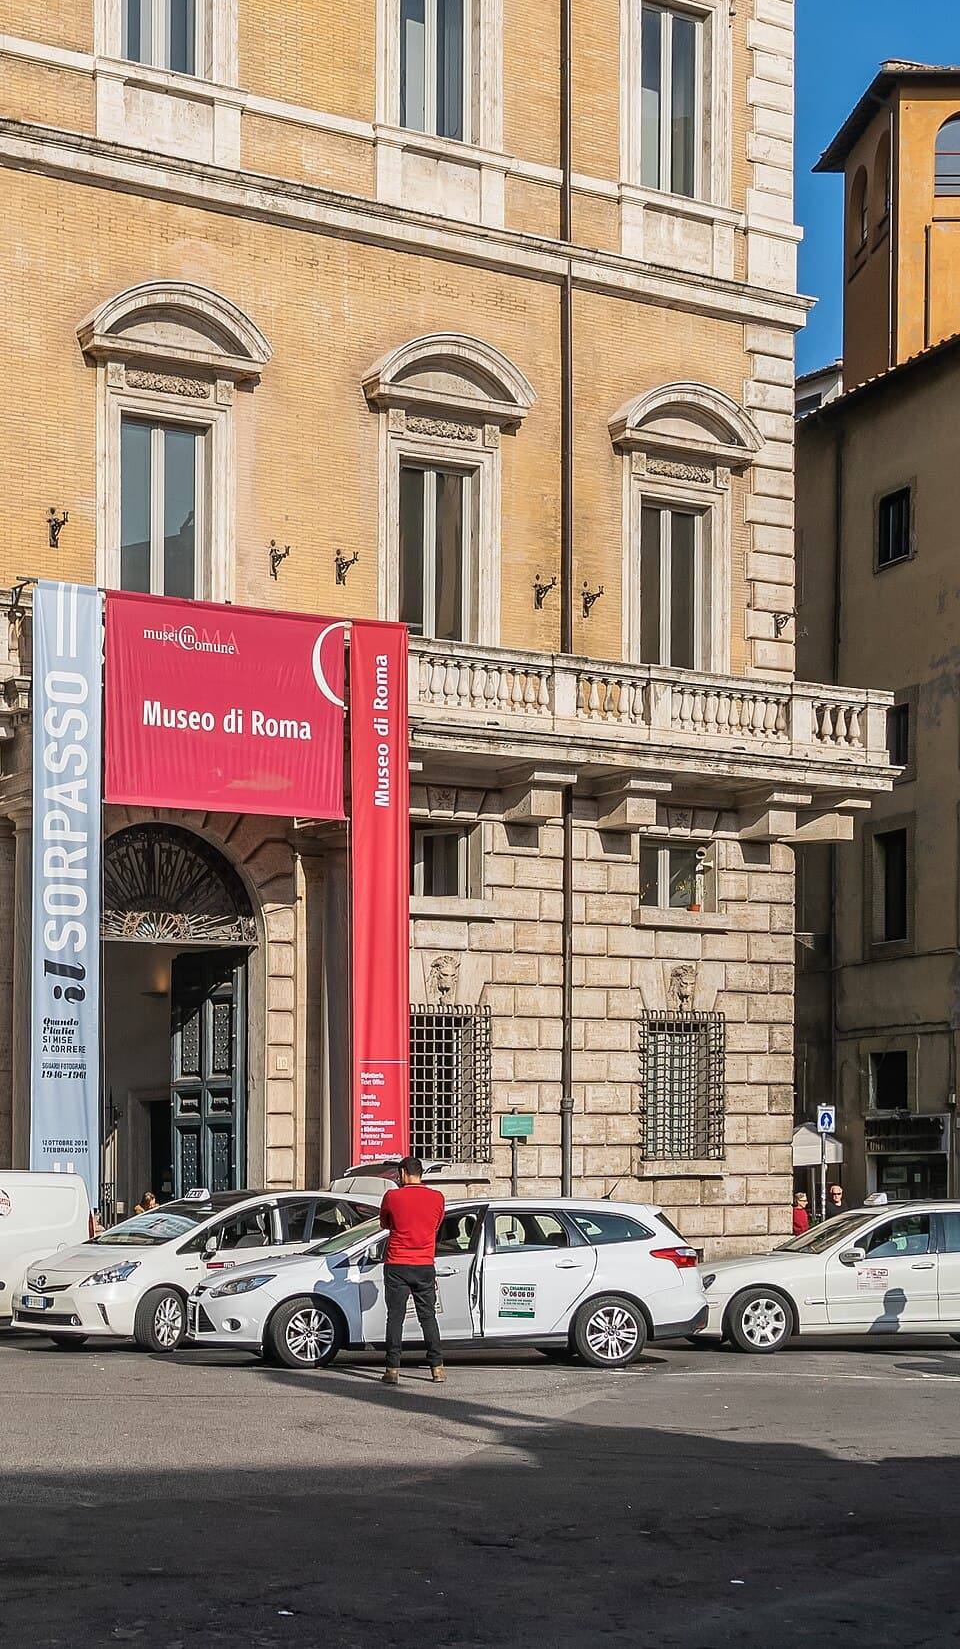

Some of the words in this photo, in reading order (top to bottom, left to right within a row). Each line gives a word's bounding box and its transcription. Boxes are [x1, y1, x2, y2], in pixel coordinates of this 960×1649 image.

[143, 629, 178, 642] musei
[373, 654, 389, 710] Roma
[143, 699, 215, 731] Museo
[223, 708, 243, 734] di
[251, 710, 312, 740] Roma
[373, 718, 389, 736] di
[375, 743, 390, 807] Museo
[43, 670, 88, 952] SORPASSO
[43, 959, 86, 1004] il
[43, 1017, 79, 1027] Quando
[42, 1036, 51, 1044] SI
[52, 1036, 73, 1044] MISE
[42, 1044, 48, 1053] A
[50, 1045, 87, 1054] CORRERE
